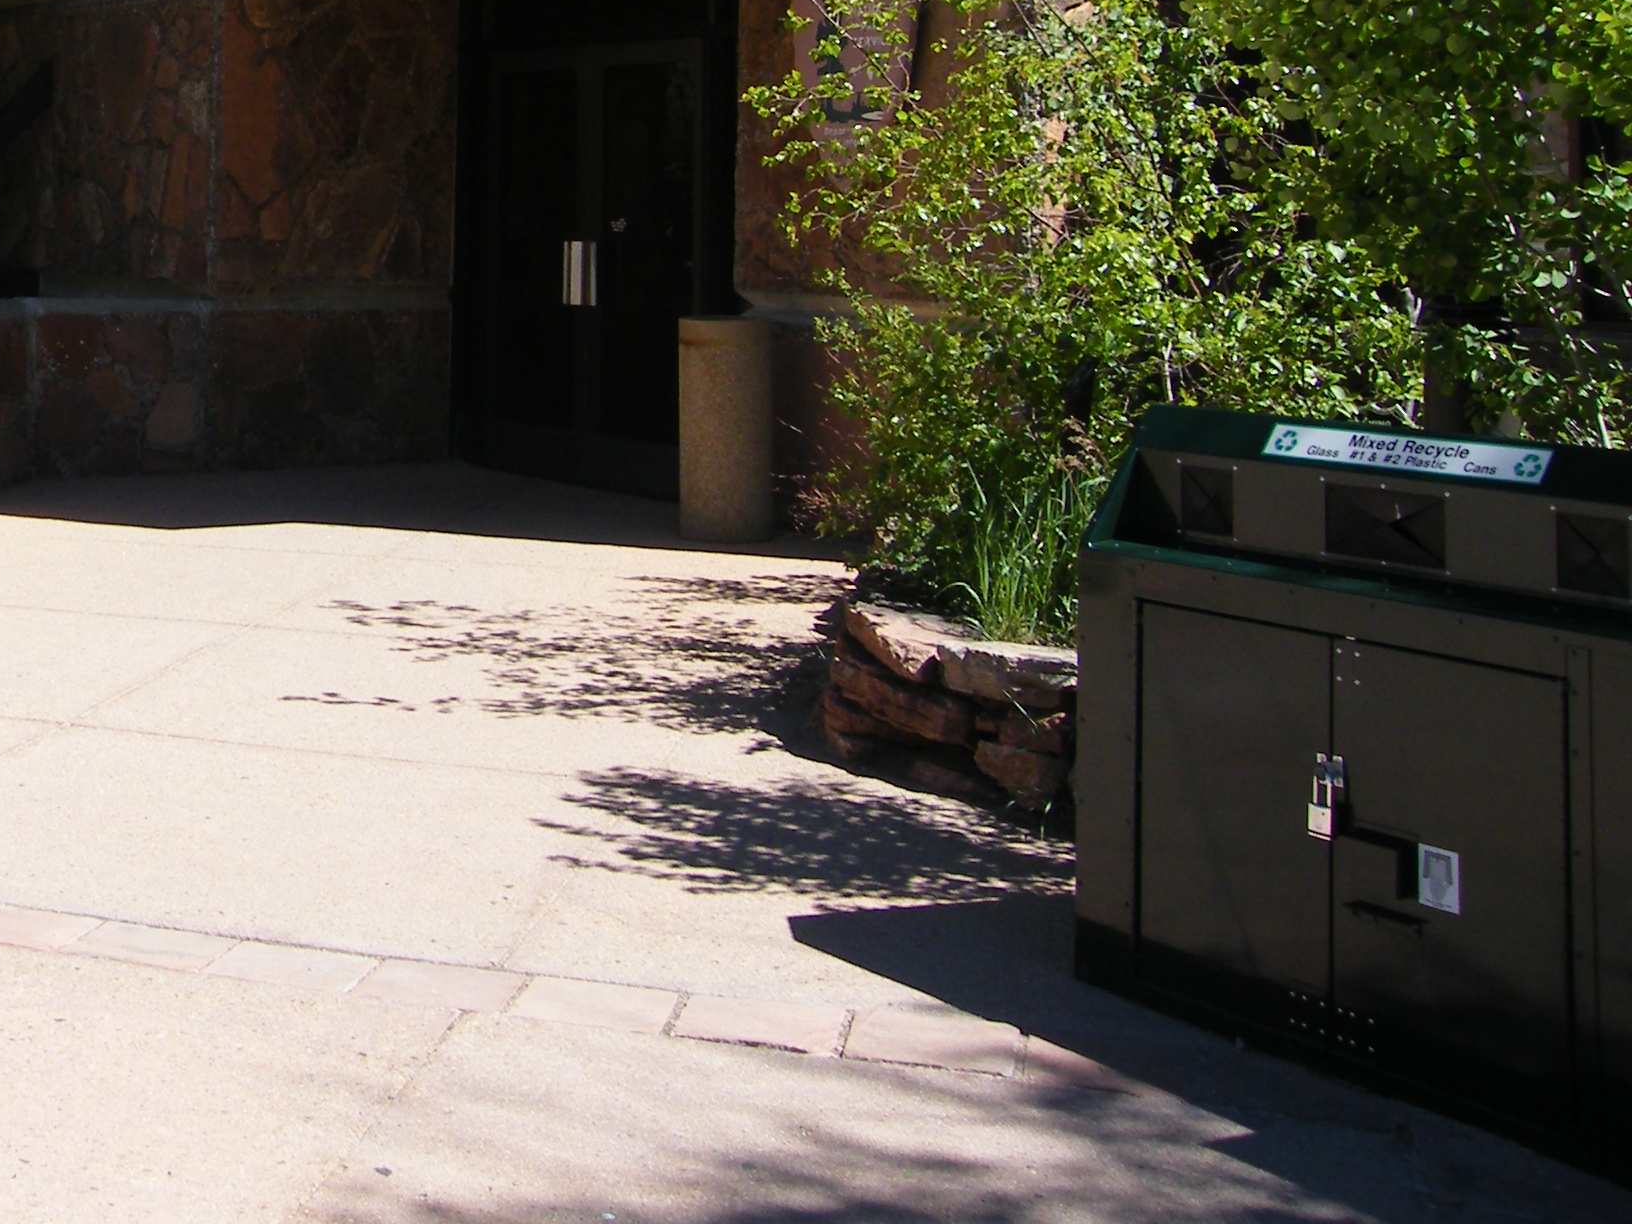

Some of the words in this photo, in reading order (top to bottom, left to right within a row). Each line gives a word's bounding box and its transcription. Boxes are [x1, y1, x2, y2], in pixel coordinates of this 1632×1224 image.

[1306, 445, 1339, 458] Glass
[1349, 449, 1364, 460] #1
[1368, 452, 1376, 462] &
[1383, 453, 1401, 465] #2
[1404, 456, 1447, 470] Plastic
[1463, 461, 1497, 475] Cans
[1348, 434, 1396, 452] Mixed
[1402, 440, 1471, 459] Recycle
